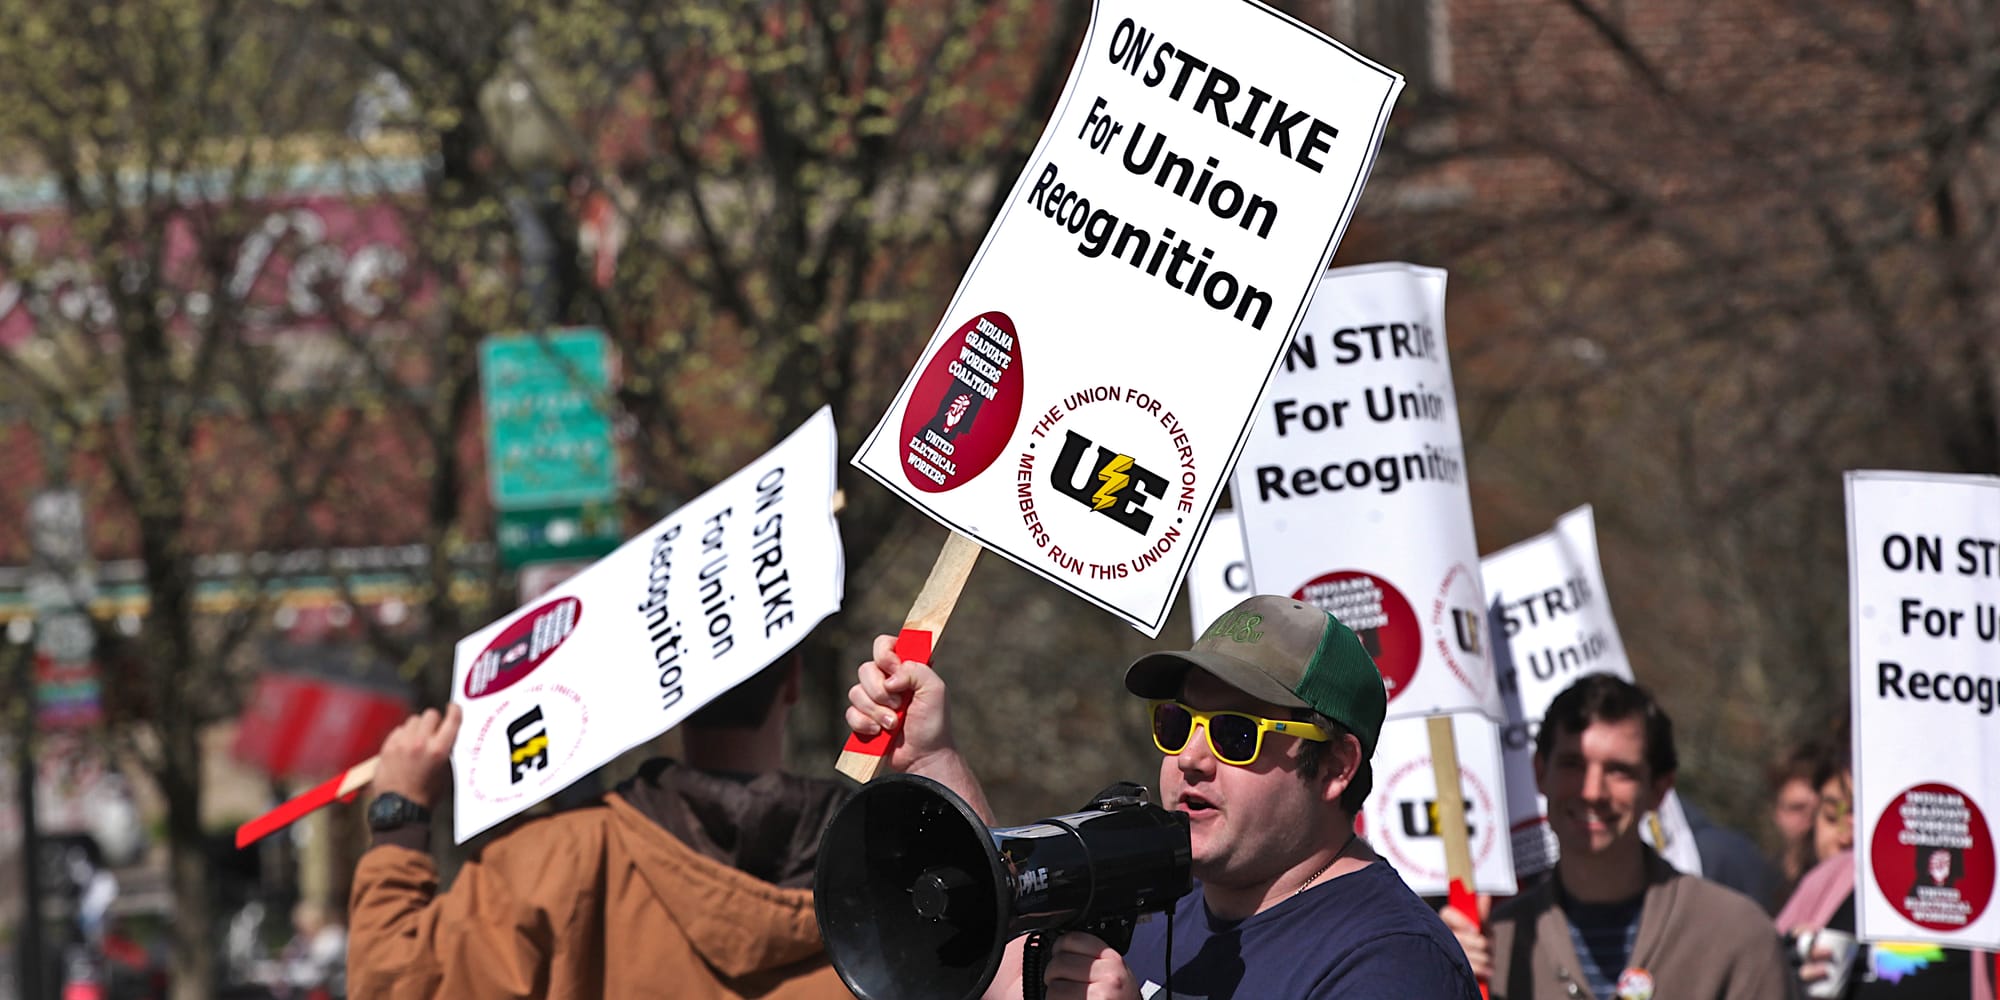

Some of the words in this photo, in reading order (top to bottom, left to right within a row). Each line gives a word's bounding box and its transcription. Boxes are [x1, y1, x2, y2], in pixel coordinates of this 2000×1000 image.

[1109, 17, 1155, 76] ON
[1143, 42, 1339, 173] STRIKE
[1078, 96, 1124, 154] For
[1123, 122, 1278, 239] Union
[1027, 161, 1273, 330] Recognition
[965, 330, 1012, 369] GRADUATE
[976, 317, 1014, 351] INDIANA
[1284, 334, 1317, 372] N
[948, 360, 998, 400] COALITION
[959, 346, 1002, 383] WORKERS
[1274, 399, 1351, 436] For
[909, 437, 957, 475] ELECTRICAL
[924, 429, 955, 455] UNITED
[1031, 405, 1064, 438] THE
[1064, 386, 1121, 411] UNION
[1126, 389, 1162, 417] FOR
[1160, 411, 1196, 513] EVERYONE
[755, 467, 784, 514] ON
[907, 452, 946, 485] WORKERS
[1050, 429, 1170, 536] UE
[704, 506, 733, 554] For
[1018, 453, 1050, 548] MEMBERS
[1048, 545, 1084, 575] RUN
[1089, 563, 1128, 579] THIS
[1132, 526, 1181, 572] UNION
[752, 514, 794, 638] STRIKE
[1882, 534, 1943, 572] ON
[1957, 537, 2000, 577] ST
[638, 523, 689, 710] Recognition
[698, 553, 734, 659] Union
[1900, 598, 1964, 638] For
[1878, 661, 2000, 716] Recog
[506, 704, 549, 785] UE
